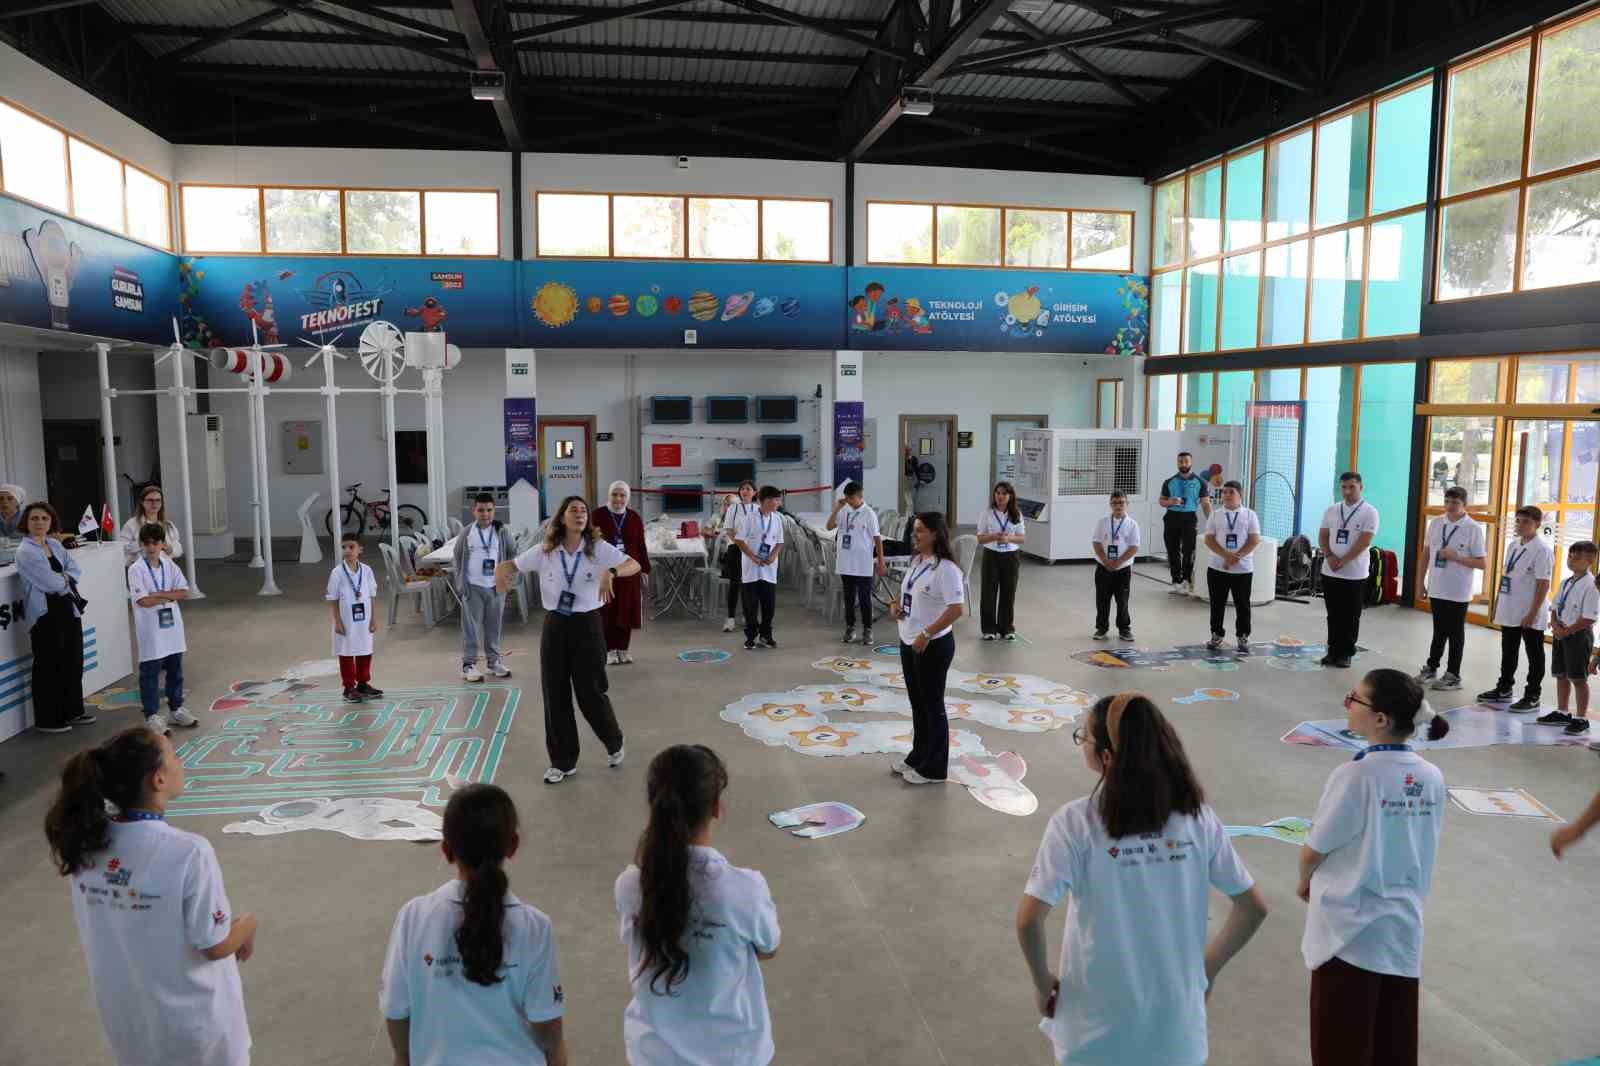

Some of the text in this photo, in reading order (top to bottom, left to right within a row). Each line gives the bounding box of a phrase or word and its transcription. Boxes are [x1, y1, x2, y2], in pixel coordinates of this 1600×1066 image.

[432, 273, 462, 281] SAMSUN
[114, 295, 143, 312] SAMSUN
[928, 301, 983, 310] TEKNOLOJİ
[301, 298, 382, 330] TEKNOFEST
[928, 311, 975, 321] ATÖLYESİ
[1052, 314, 1097, 324] ATÖLYESİ
